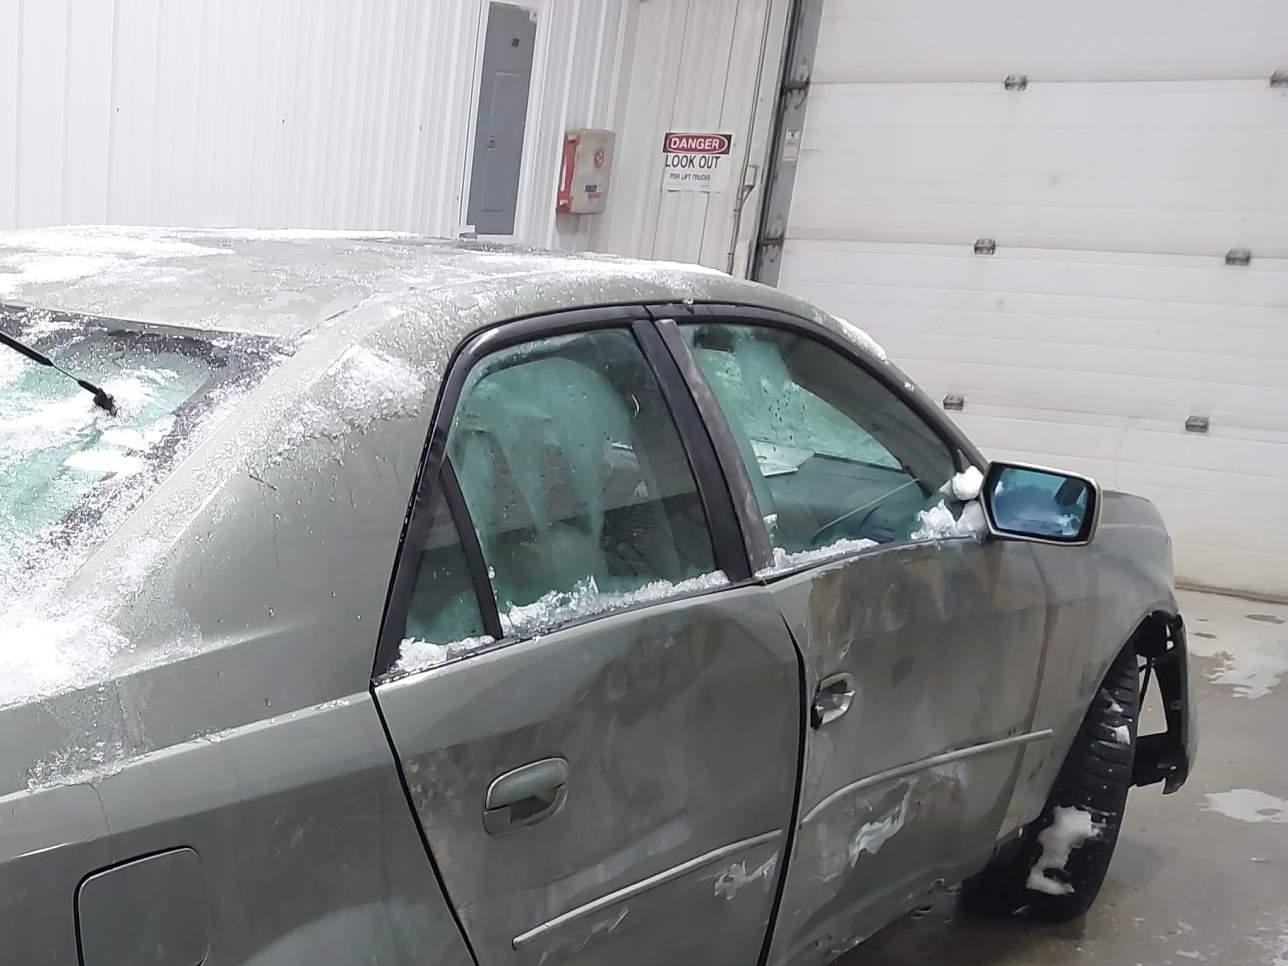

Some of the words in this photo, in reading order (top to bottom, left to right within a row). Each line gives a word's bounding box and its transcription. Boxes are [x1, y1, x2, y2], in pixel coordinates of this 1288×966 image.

[670, 138, 720, 149] DANGER
[665, 154, 696, 168] LOOK
[699, 155, 721, 168] OUT
